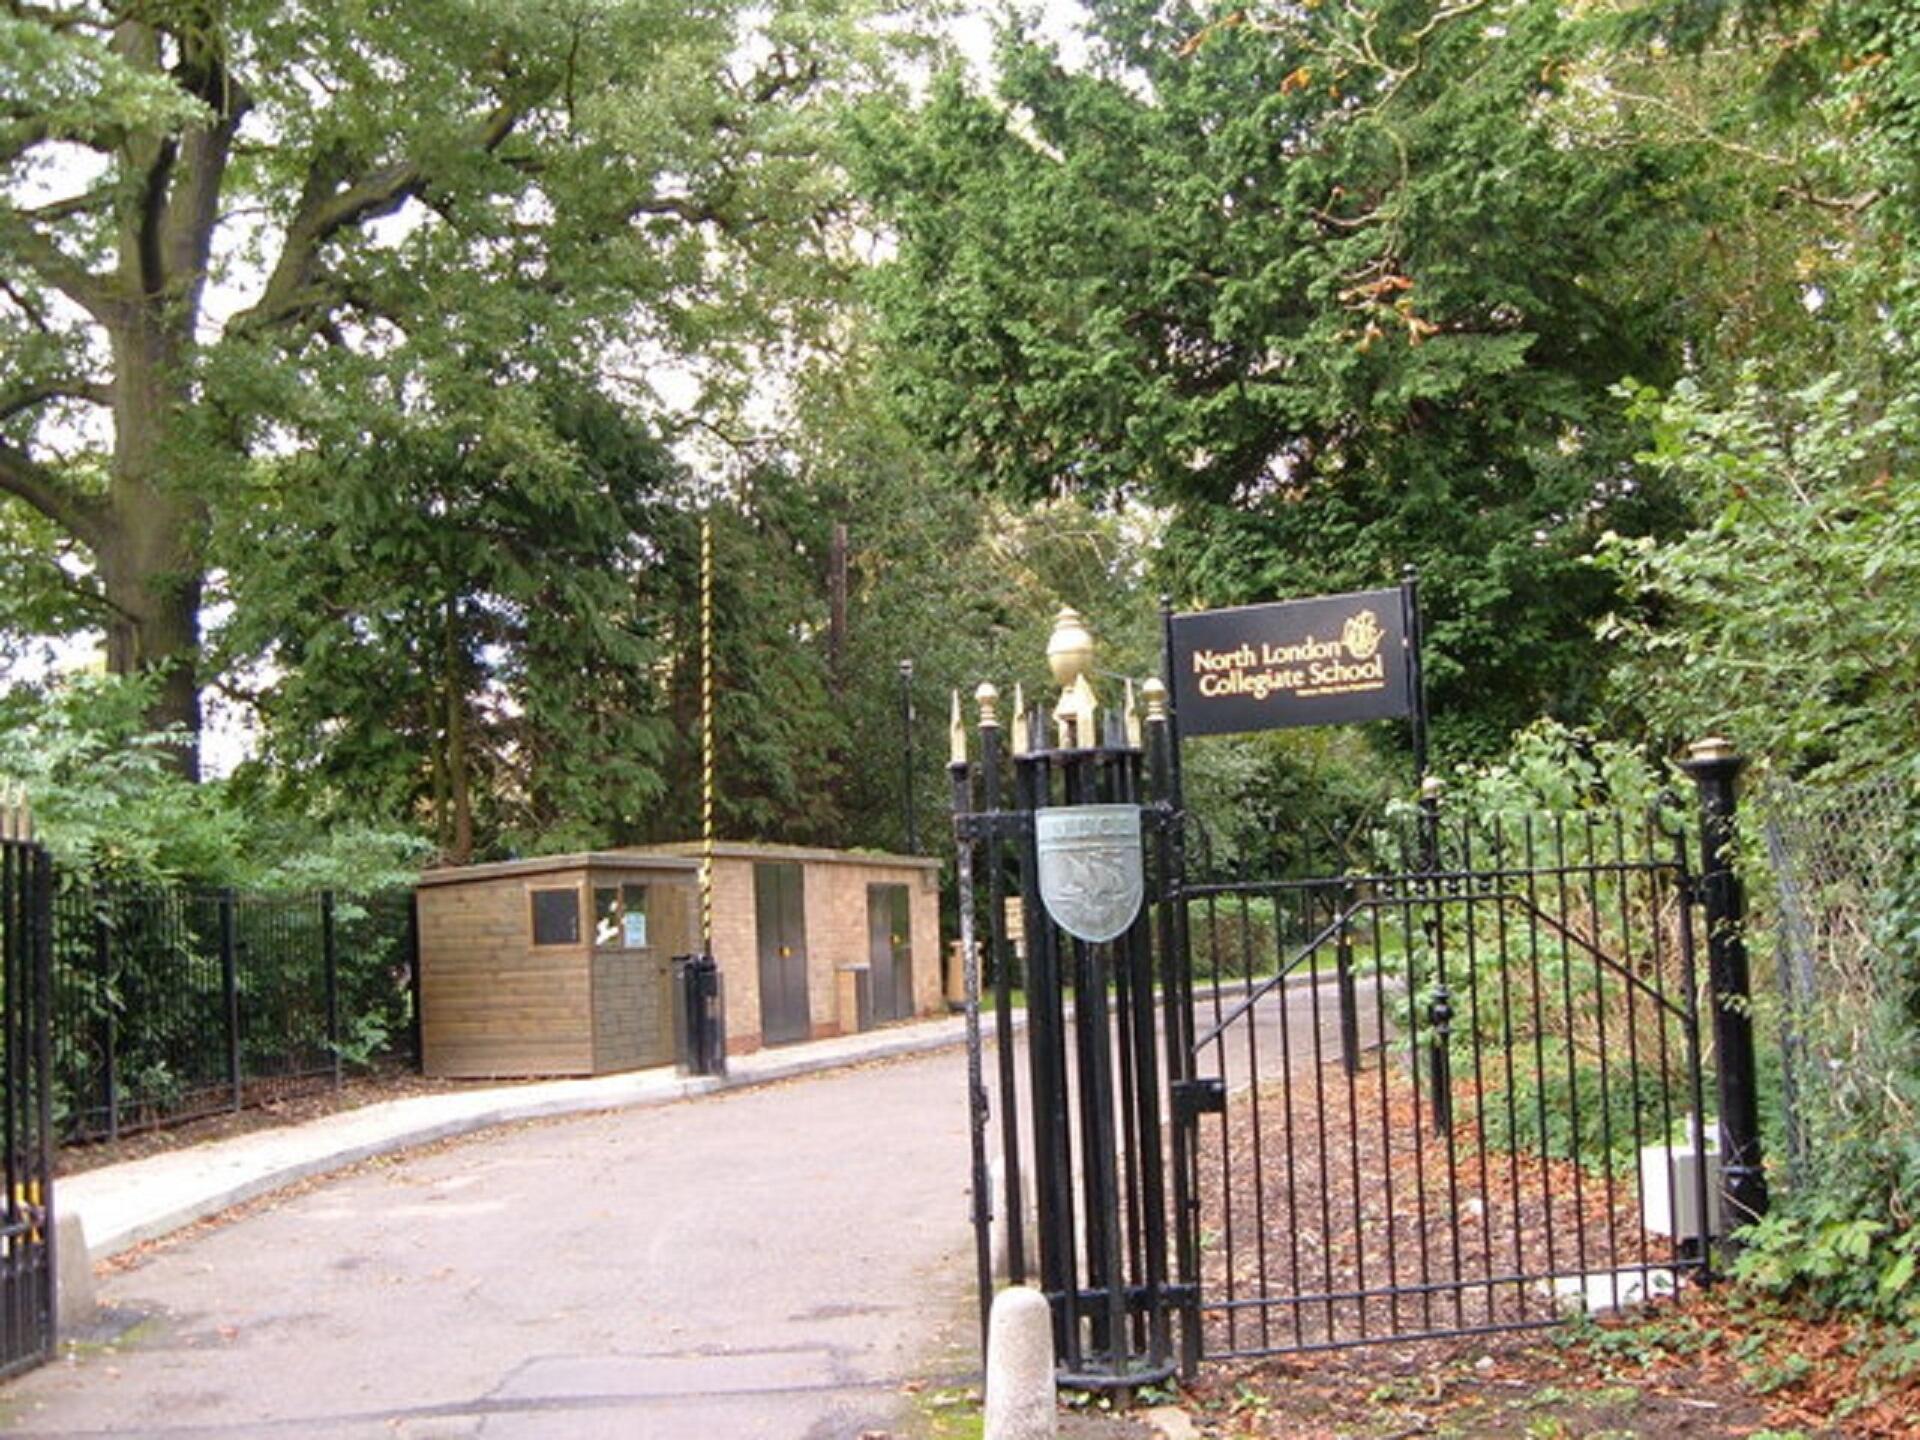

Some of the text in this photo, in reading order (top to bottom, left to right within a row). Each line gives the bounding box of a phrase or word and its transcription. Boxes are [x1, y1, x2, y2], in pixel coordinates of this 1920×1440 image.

[1193, 635, 1342, 673] North London
[1200, 667, 1305, 700] Collegiate
[1309, 654, 1384, 685] School
